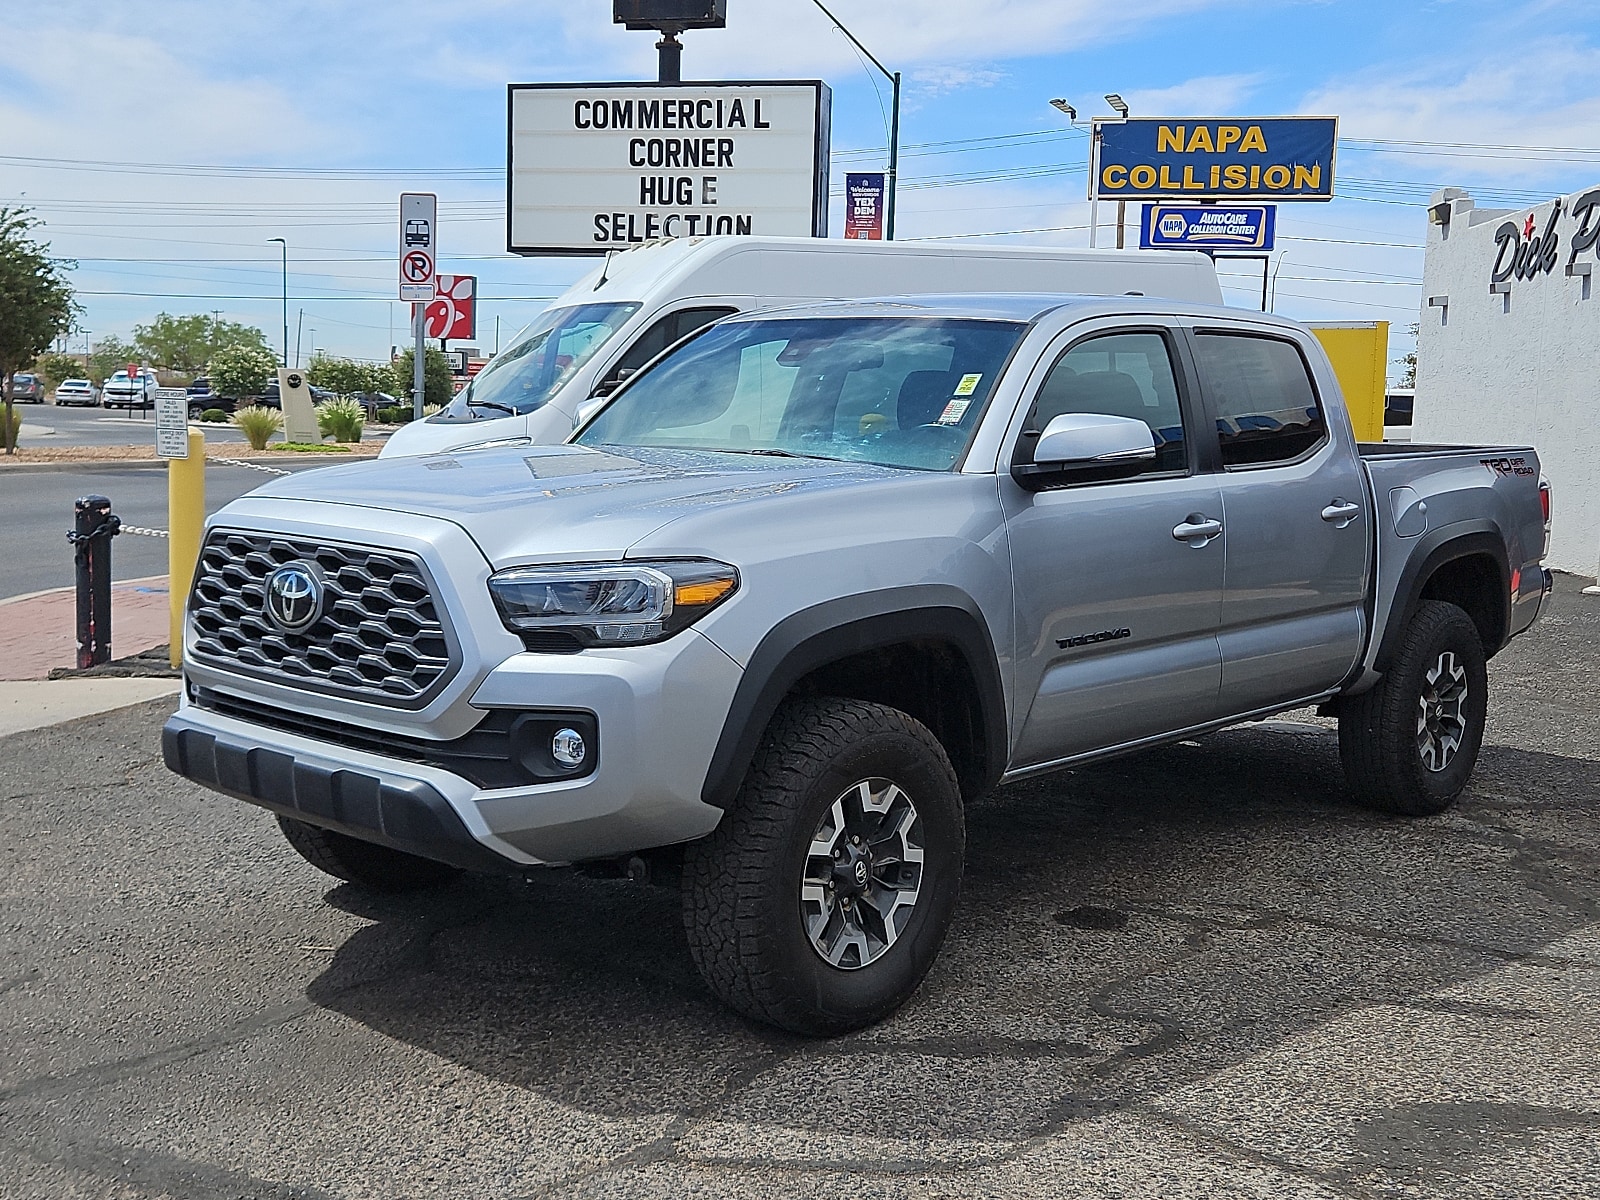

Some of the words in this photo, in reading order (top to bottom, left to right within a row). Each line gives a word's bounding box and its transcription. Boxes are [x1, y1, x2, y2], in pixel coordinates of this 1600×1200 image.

[574, 98, 770, 129] COMMERCIAL
[1157, 126, 1267, 153] NAPA
[629, 137, 734, 167] CORNER
[1102, 165, 1321, 189] COLLISION
[854, 197, 876, 206] TEX
[854, 207, 876, 215] DEM
[593, 213, 752, 242] SELECTION
[1163, 220, 1183, 232] NAPA
[1227, 224, 1256, 234] CENTER
[1491, 196, 1561, 283] Dick
[1480, 457, 1513, 478] TRD
[1510, 457, 1525, 465] OFF
[1513, 467, 1534, 477] ROAD
[1056, 628, 1131, 649] TACOMA
